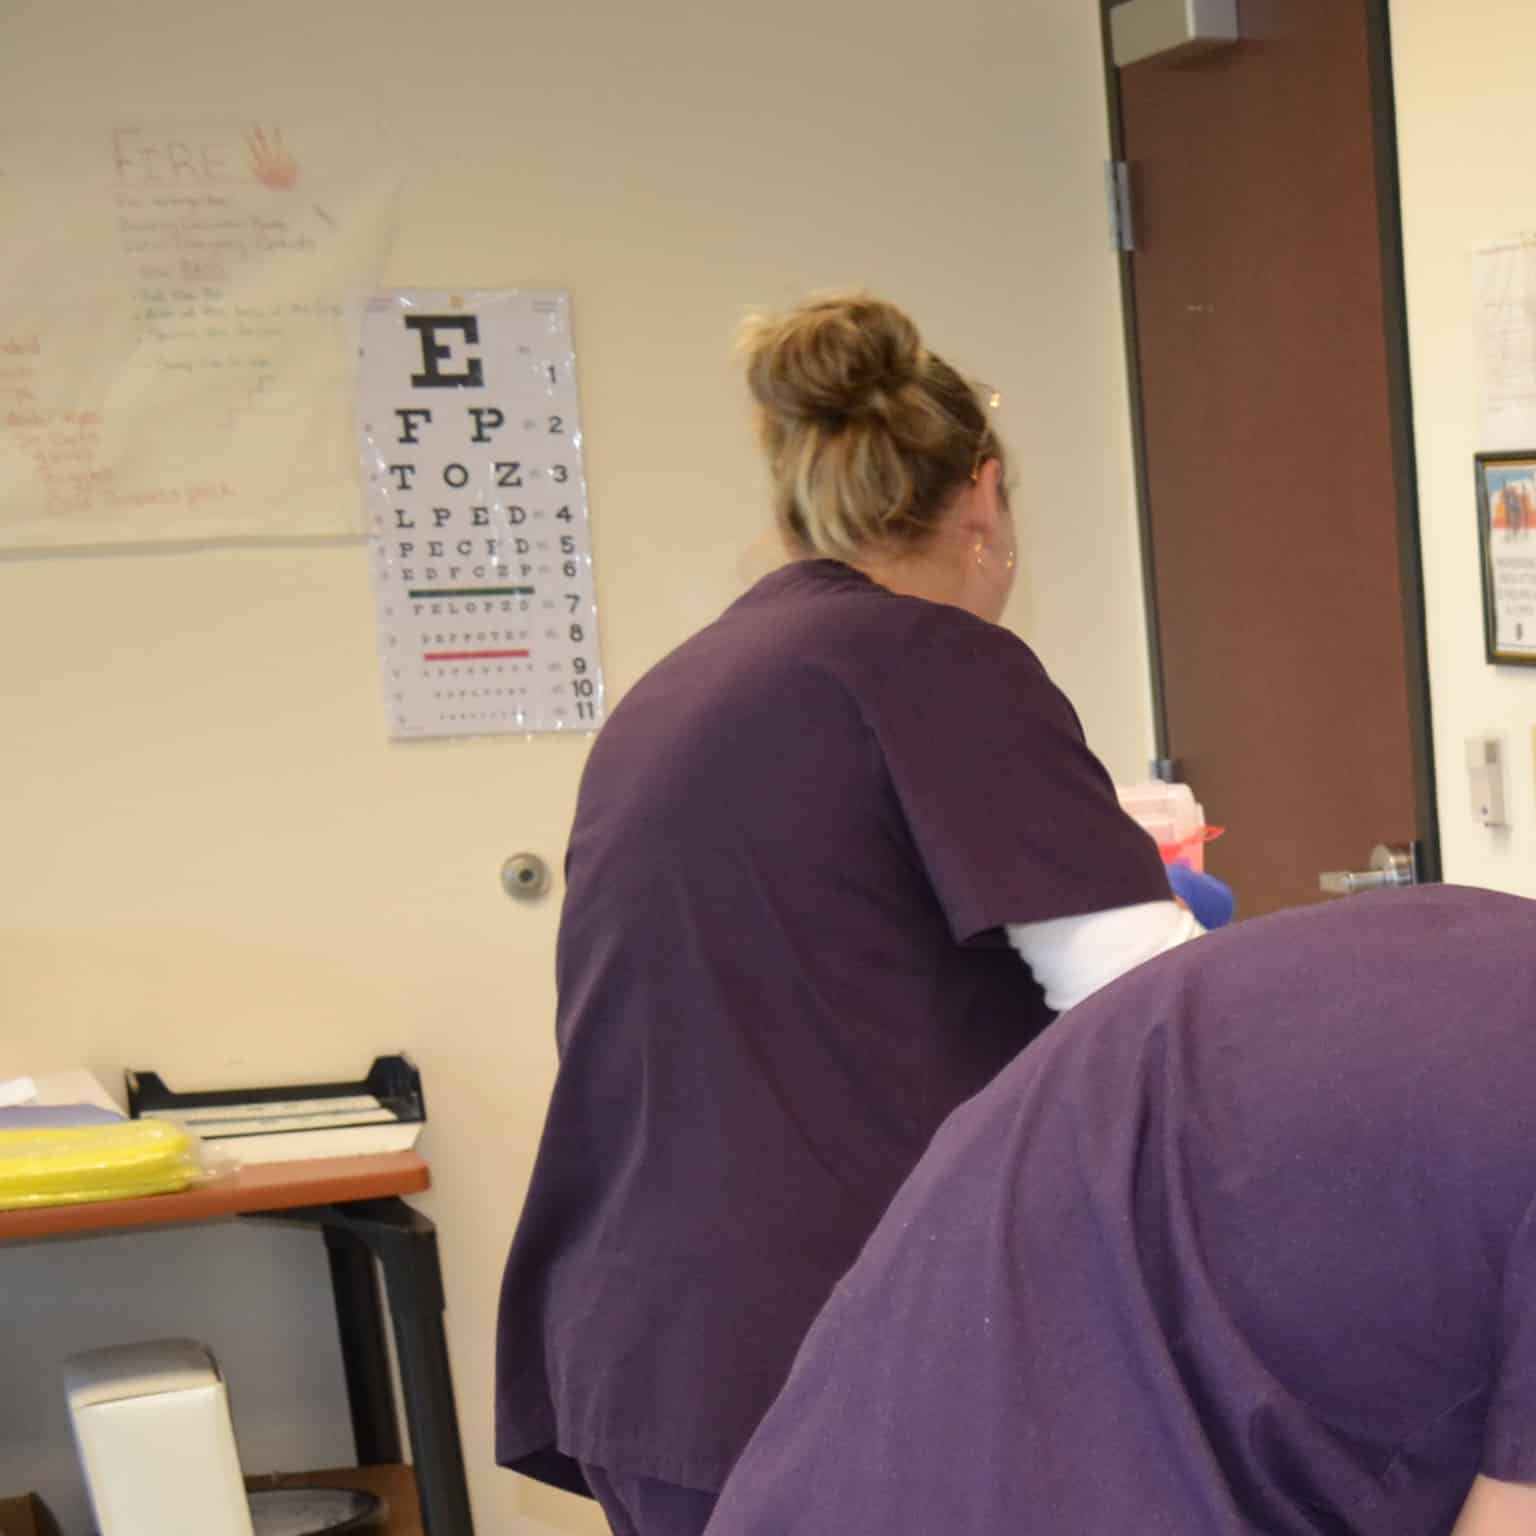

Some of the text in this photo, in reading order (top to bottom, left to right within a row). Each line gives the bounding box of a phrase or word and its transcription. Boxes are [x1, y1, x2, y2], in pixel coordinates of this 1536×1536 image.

[402, 314, 558, 390] E 1
[395, 407, 563, 444] F P 2
[390, 461, 569, 492] T O Z 3
[555, 505, 573, 525] 4
[560, 535, 575, 555] 5
[562, 560, 576, 578] 6
[564, 594, 581, 614] 7
[569, 623, 584, 643] 8
[572, 656, 588, 675] 9
[572, 679, 594, 698] 10
[576, 703, 595, 720] 11
